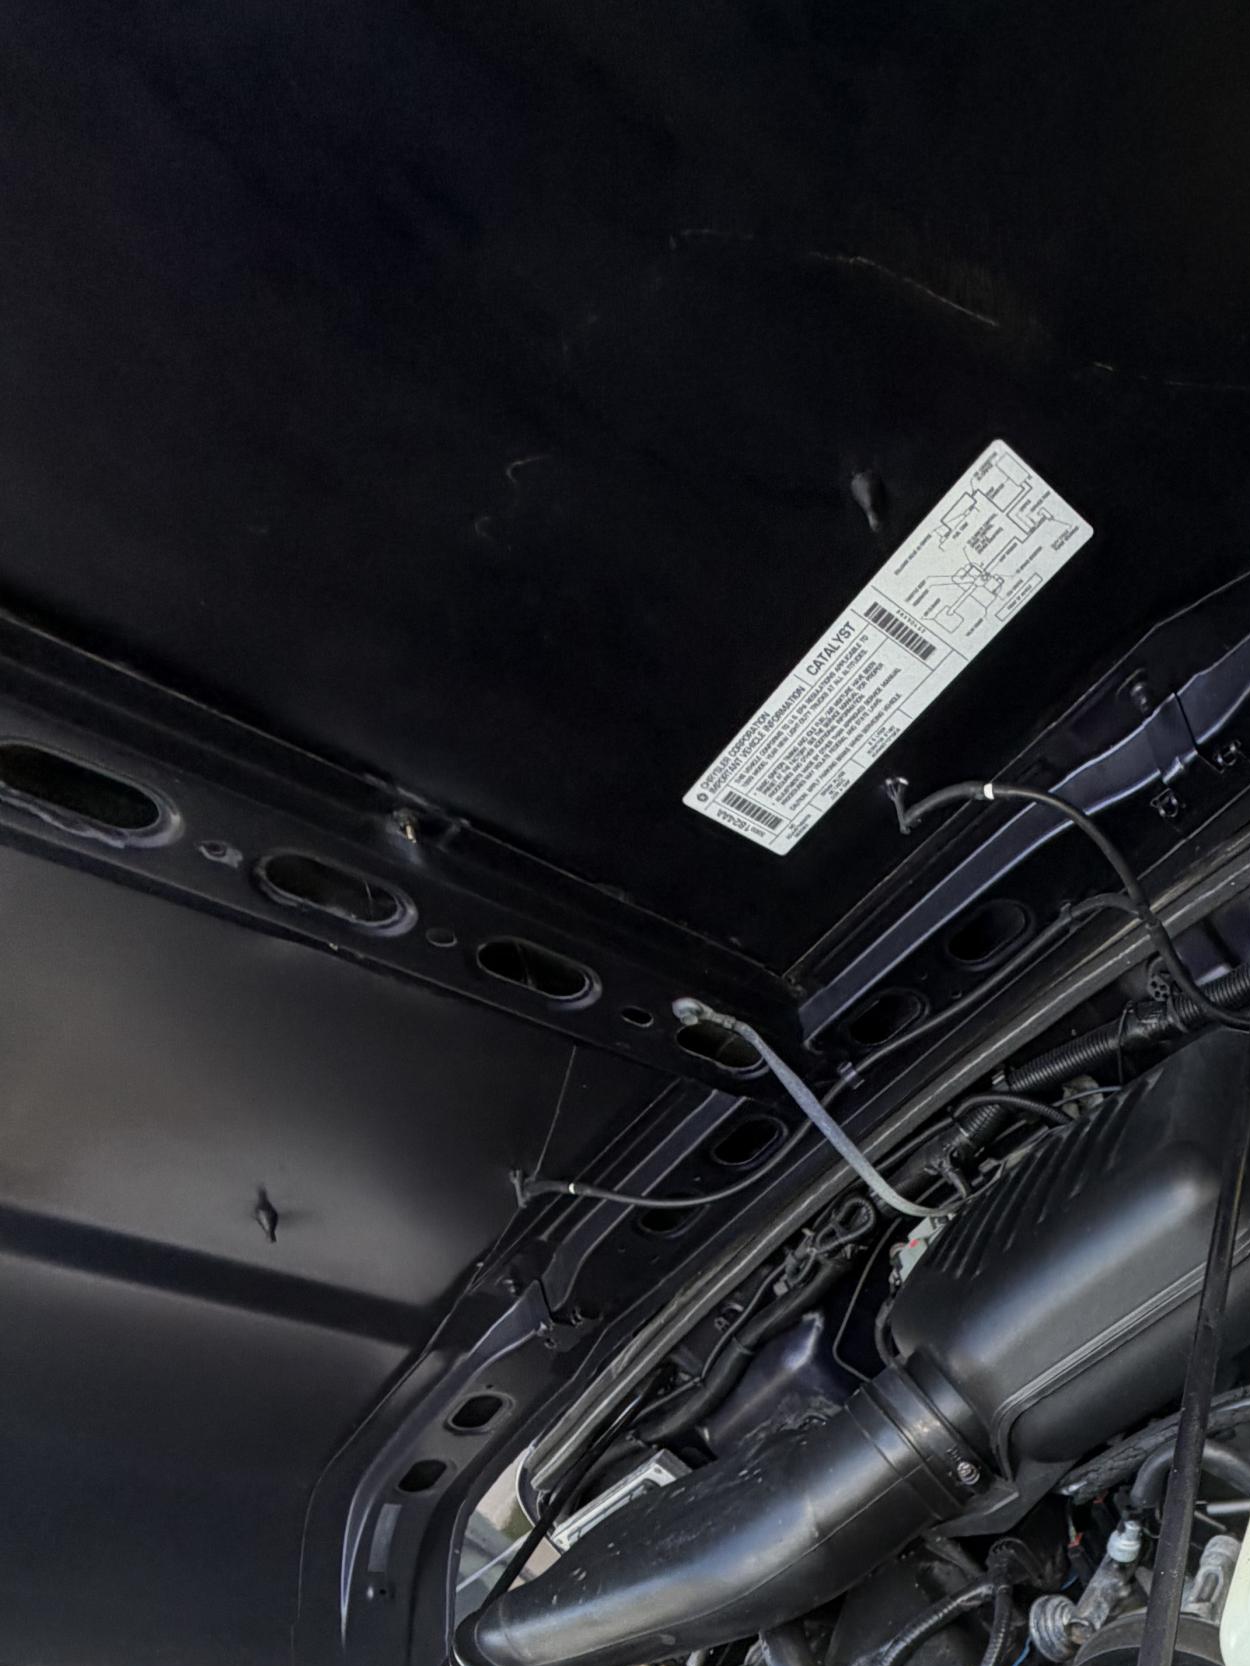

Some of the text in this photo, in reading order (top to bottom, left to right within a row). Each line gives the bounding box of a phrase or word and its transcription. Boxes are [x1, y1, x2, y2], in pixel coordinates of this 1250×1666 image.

[803, 619, 858, 677] CATALYST
[698, 710, 771, 790] CHRYSLER CORPORATION
[706, 684, 807, 795] IMPORTANT VEHICLE INFORMATION
